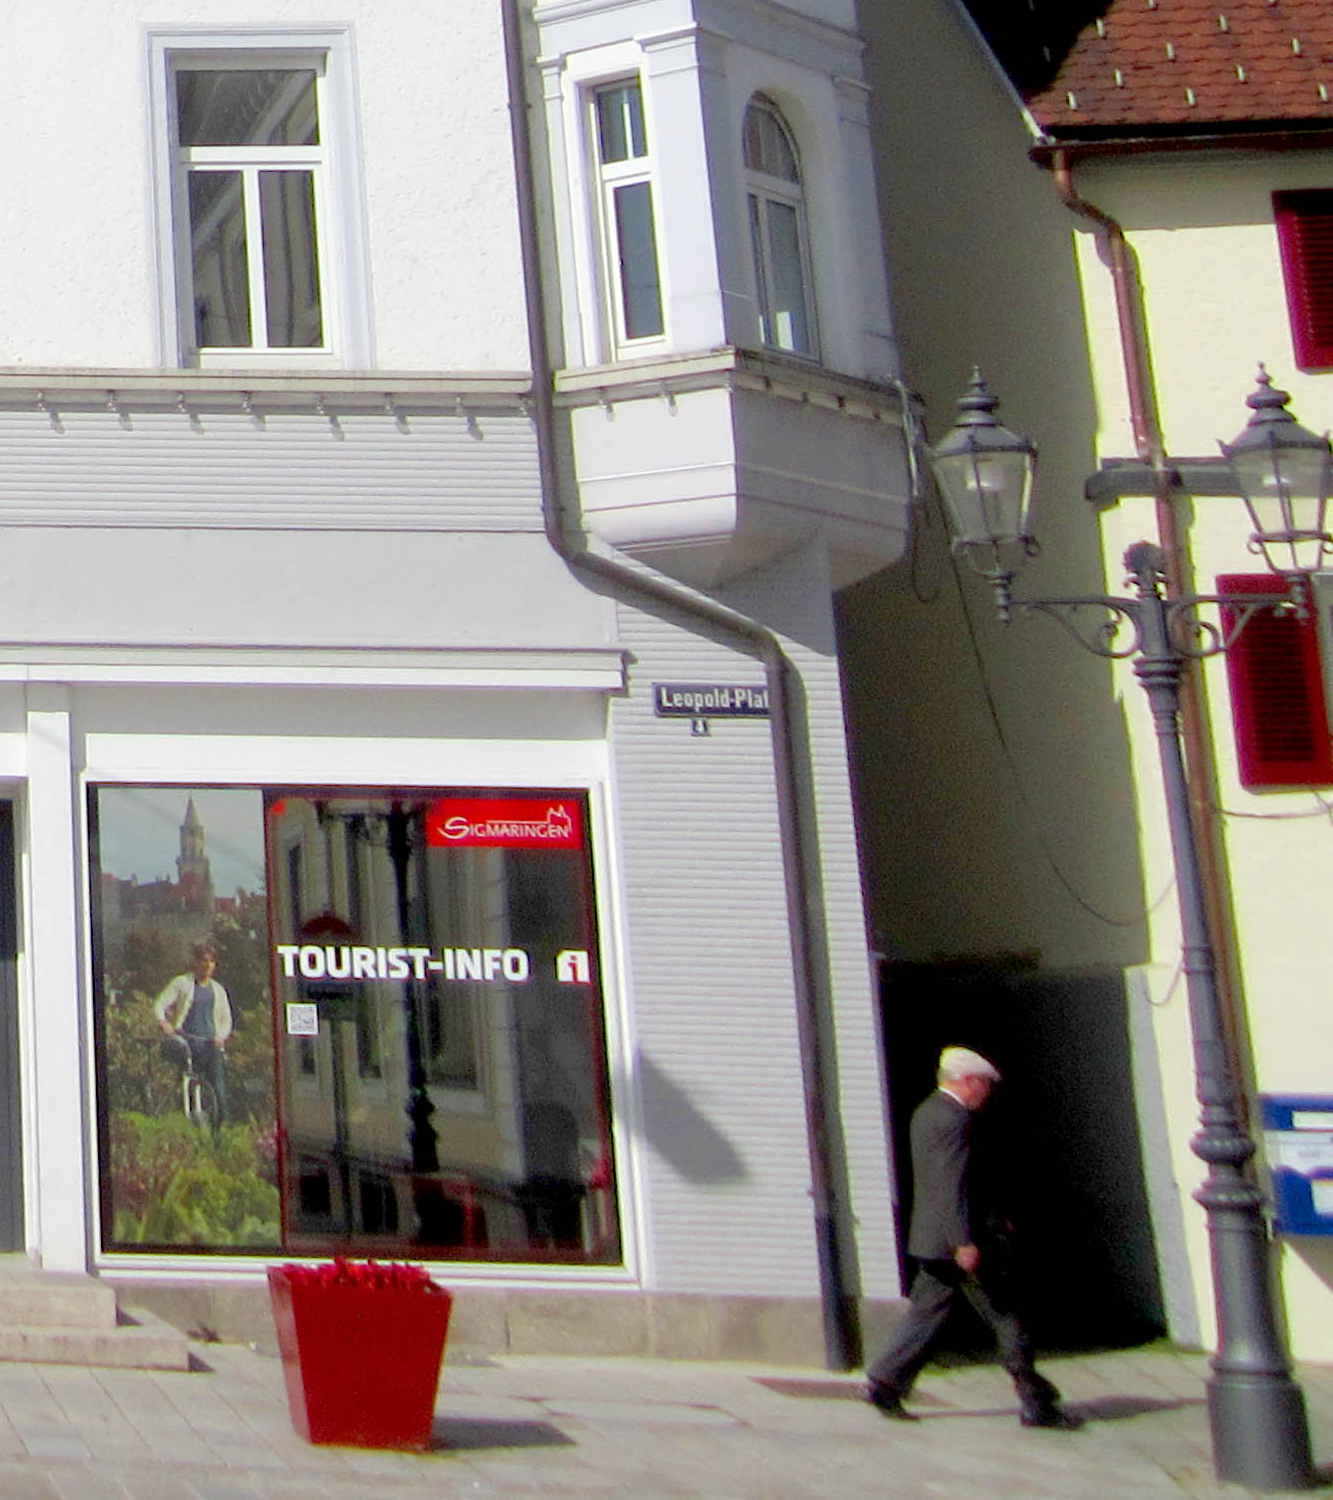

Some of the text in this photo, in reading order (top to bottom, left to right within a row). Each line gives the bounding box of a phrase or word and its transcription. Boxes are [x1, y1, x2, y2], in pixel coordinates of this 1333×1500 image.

[660, 686, 769, 712] Leopold-Plat
[438, 816, 570, 839] SIGMARINGEN
[276, 944, 530, 982] TOURIST-INFO
